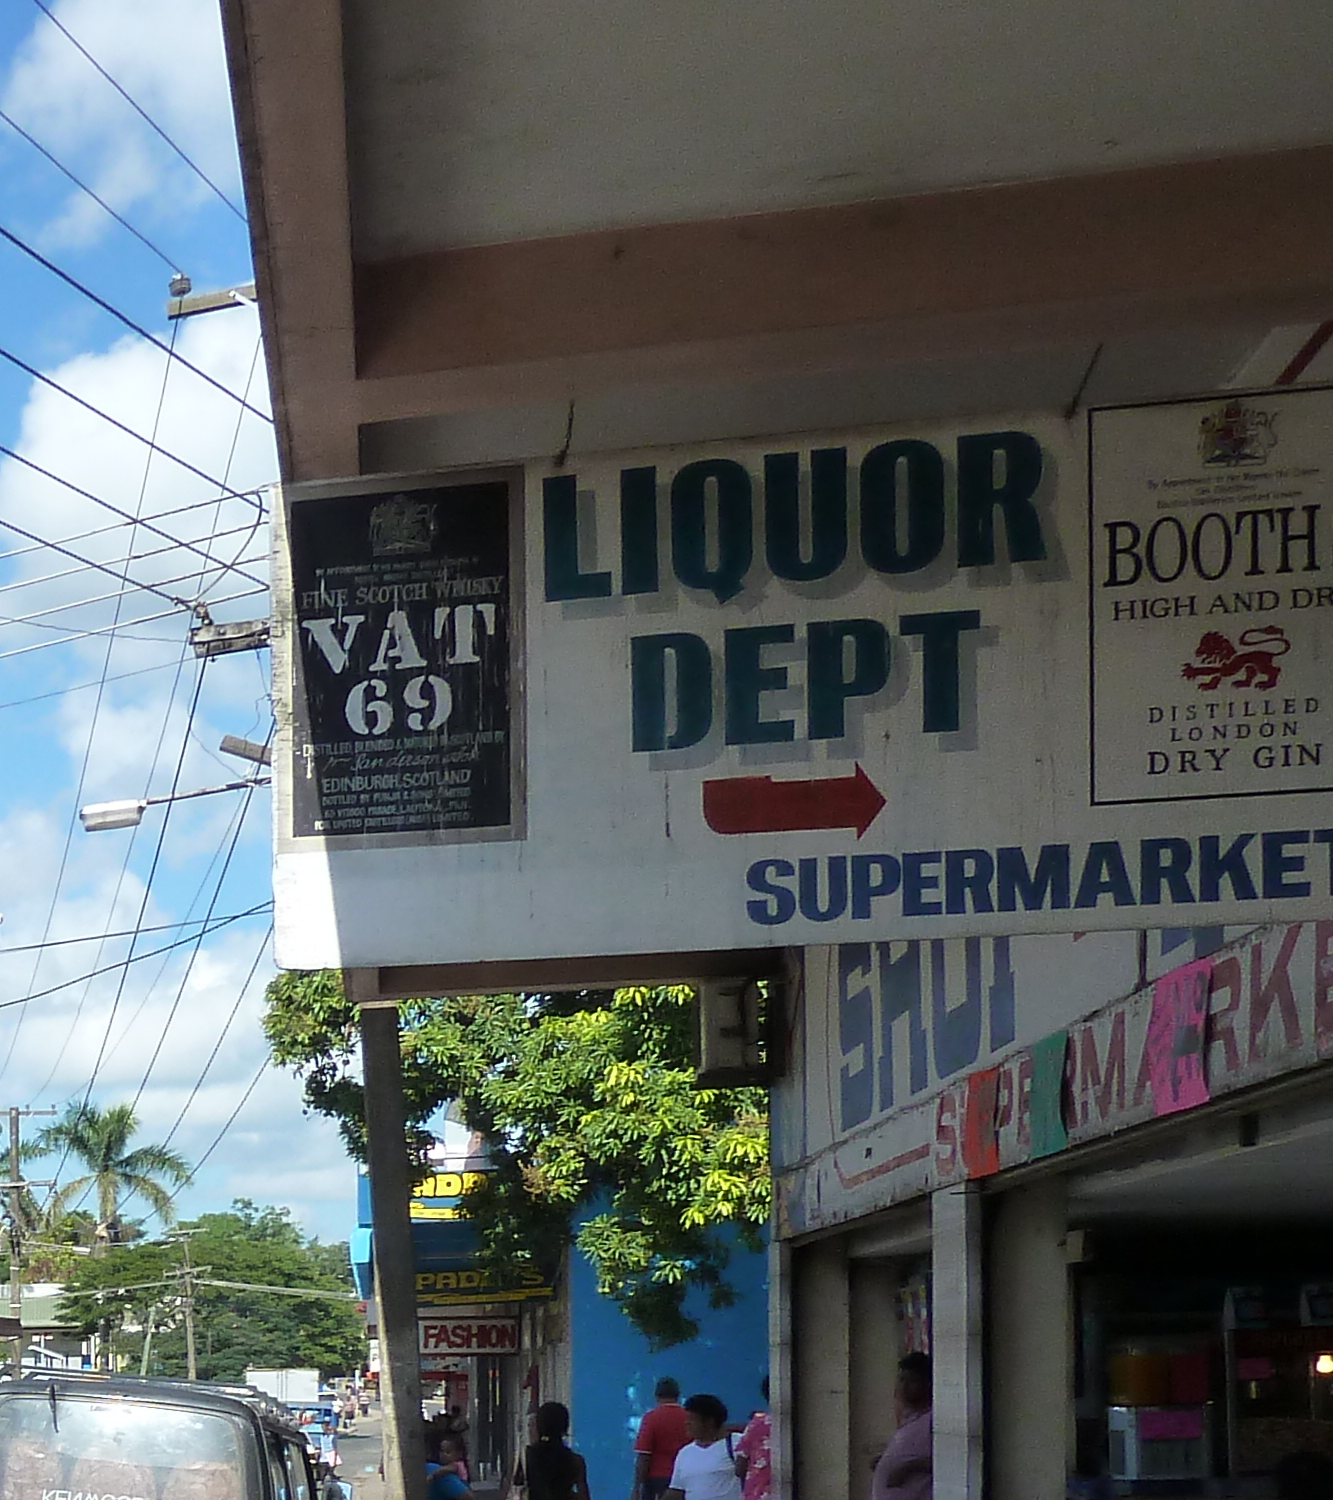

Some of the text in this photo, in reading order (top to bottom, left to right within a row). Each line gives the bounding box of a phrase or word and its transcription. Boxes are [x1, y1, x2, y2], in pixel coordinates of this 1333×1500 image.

[541, 430, 1050, 605] LIQUOR
[1102, 504, 1322, 588] BOOTH
[301, 588, 349, 609] FINE
[355, 582, 428, 605] SCOTCH
[432, 575, 505, 599] WHISKY
[1112, 595, 1198, 622] HIGH
[1208, 591, 1281, 616] AND
[300, 602, 497, 675] VAT
[630, 609, 981, 753] DEPT
[344, 674, 453, 736] 69
[1148, 697, 1320, 724] DISTILLED
[1169, 720, 1299, 743] LONDON
[1146, 743, 1324, 776] DRY GIN
[422, 1323, 518, 1350] FASHION
